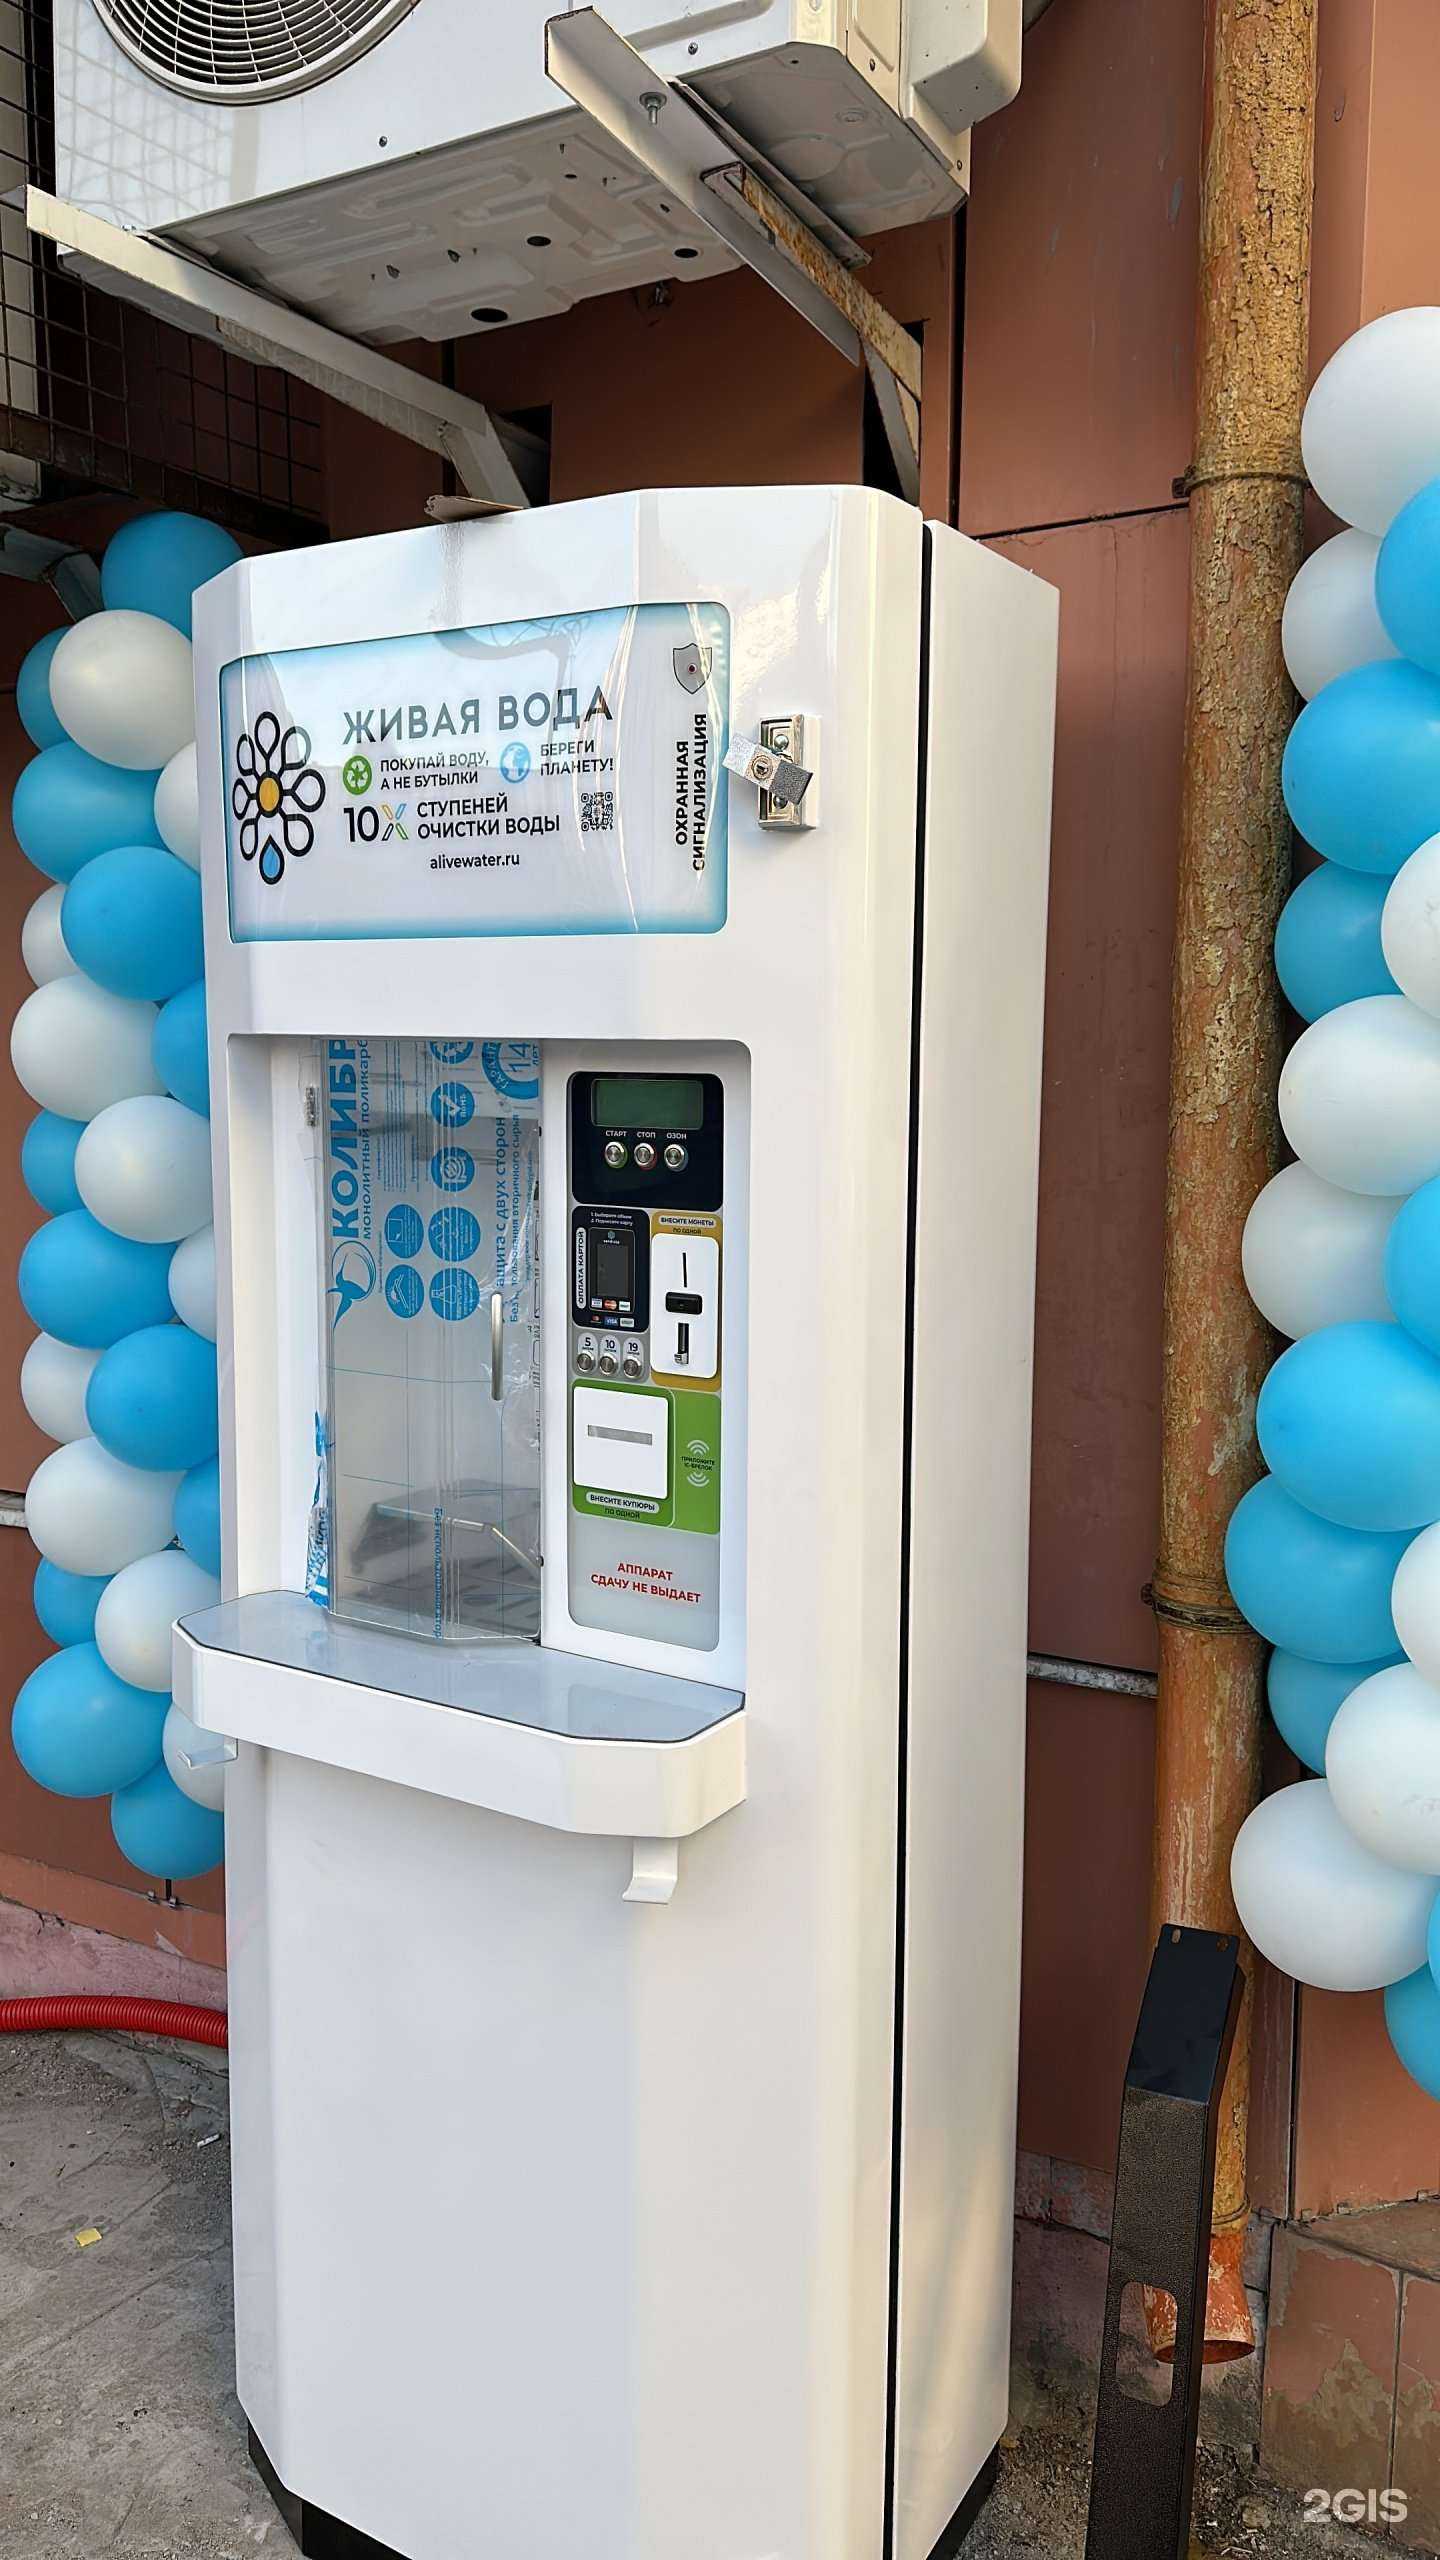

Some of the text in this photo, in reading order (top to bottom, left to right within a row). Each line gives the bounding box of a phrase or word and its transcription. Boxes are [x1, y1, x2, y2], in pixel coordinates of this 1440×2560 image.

[342, 685, 613, 745] ЖИВАЯ ВОДА
[540, 739, 595, 757] БЕРЕГИ
[380, 751, 489, 772] ПОКУПАЙ ВОДУ,
[540, 758, 614, 776] ПЛАНЕТУ!
[380, 771, 479, 790] А НЕ БУТЫЛКИ
[675, 741, 689, 846] ОХРАННАЯ
[692, 713, 709, 871] СИГНАЛИЗАЦИЯ
[417, 793, 508, 818] СТУПЕНЕЙ
[417, 815, 560, 839] ОЧИСТКИ ВОДЫ
[430, 853, 520, 869] alivewater.ru
[509, 1042, 531, 1073] 14
[605, 1130, 628, 1138] СТАРТ
[636, 1131, 657, 1139] СТОП
[666, 1132, 688, 1140] ОЗОН
[495, 1117, 509, 1176] сторон
[357, 1127, 372, 1240] монолитный
[495, 1180, 509, 1220] двух
[660, 1217, 714, 1226] ВНЕСИТЕ МОНЕТЫ
[495, 1236, 507, 1287] ащита
[584, 1337, 592, 1347] 5
[605, 1339, 615, 1349] 10
[628, 1342, 638, 1352] 19
[590, 1494, 656, 1511] ВНЕСИТЕ КУПЮРЫ
[617, 1562, 673, 1581] АППАРАТ
[591, 1573, 701, 1603] СДАЧУ НЕ ВЫДАЕТ
